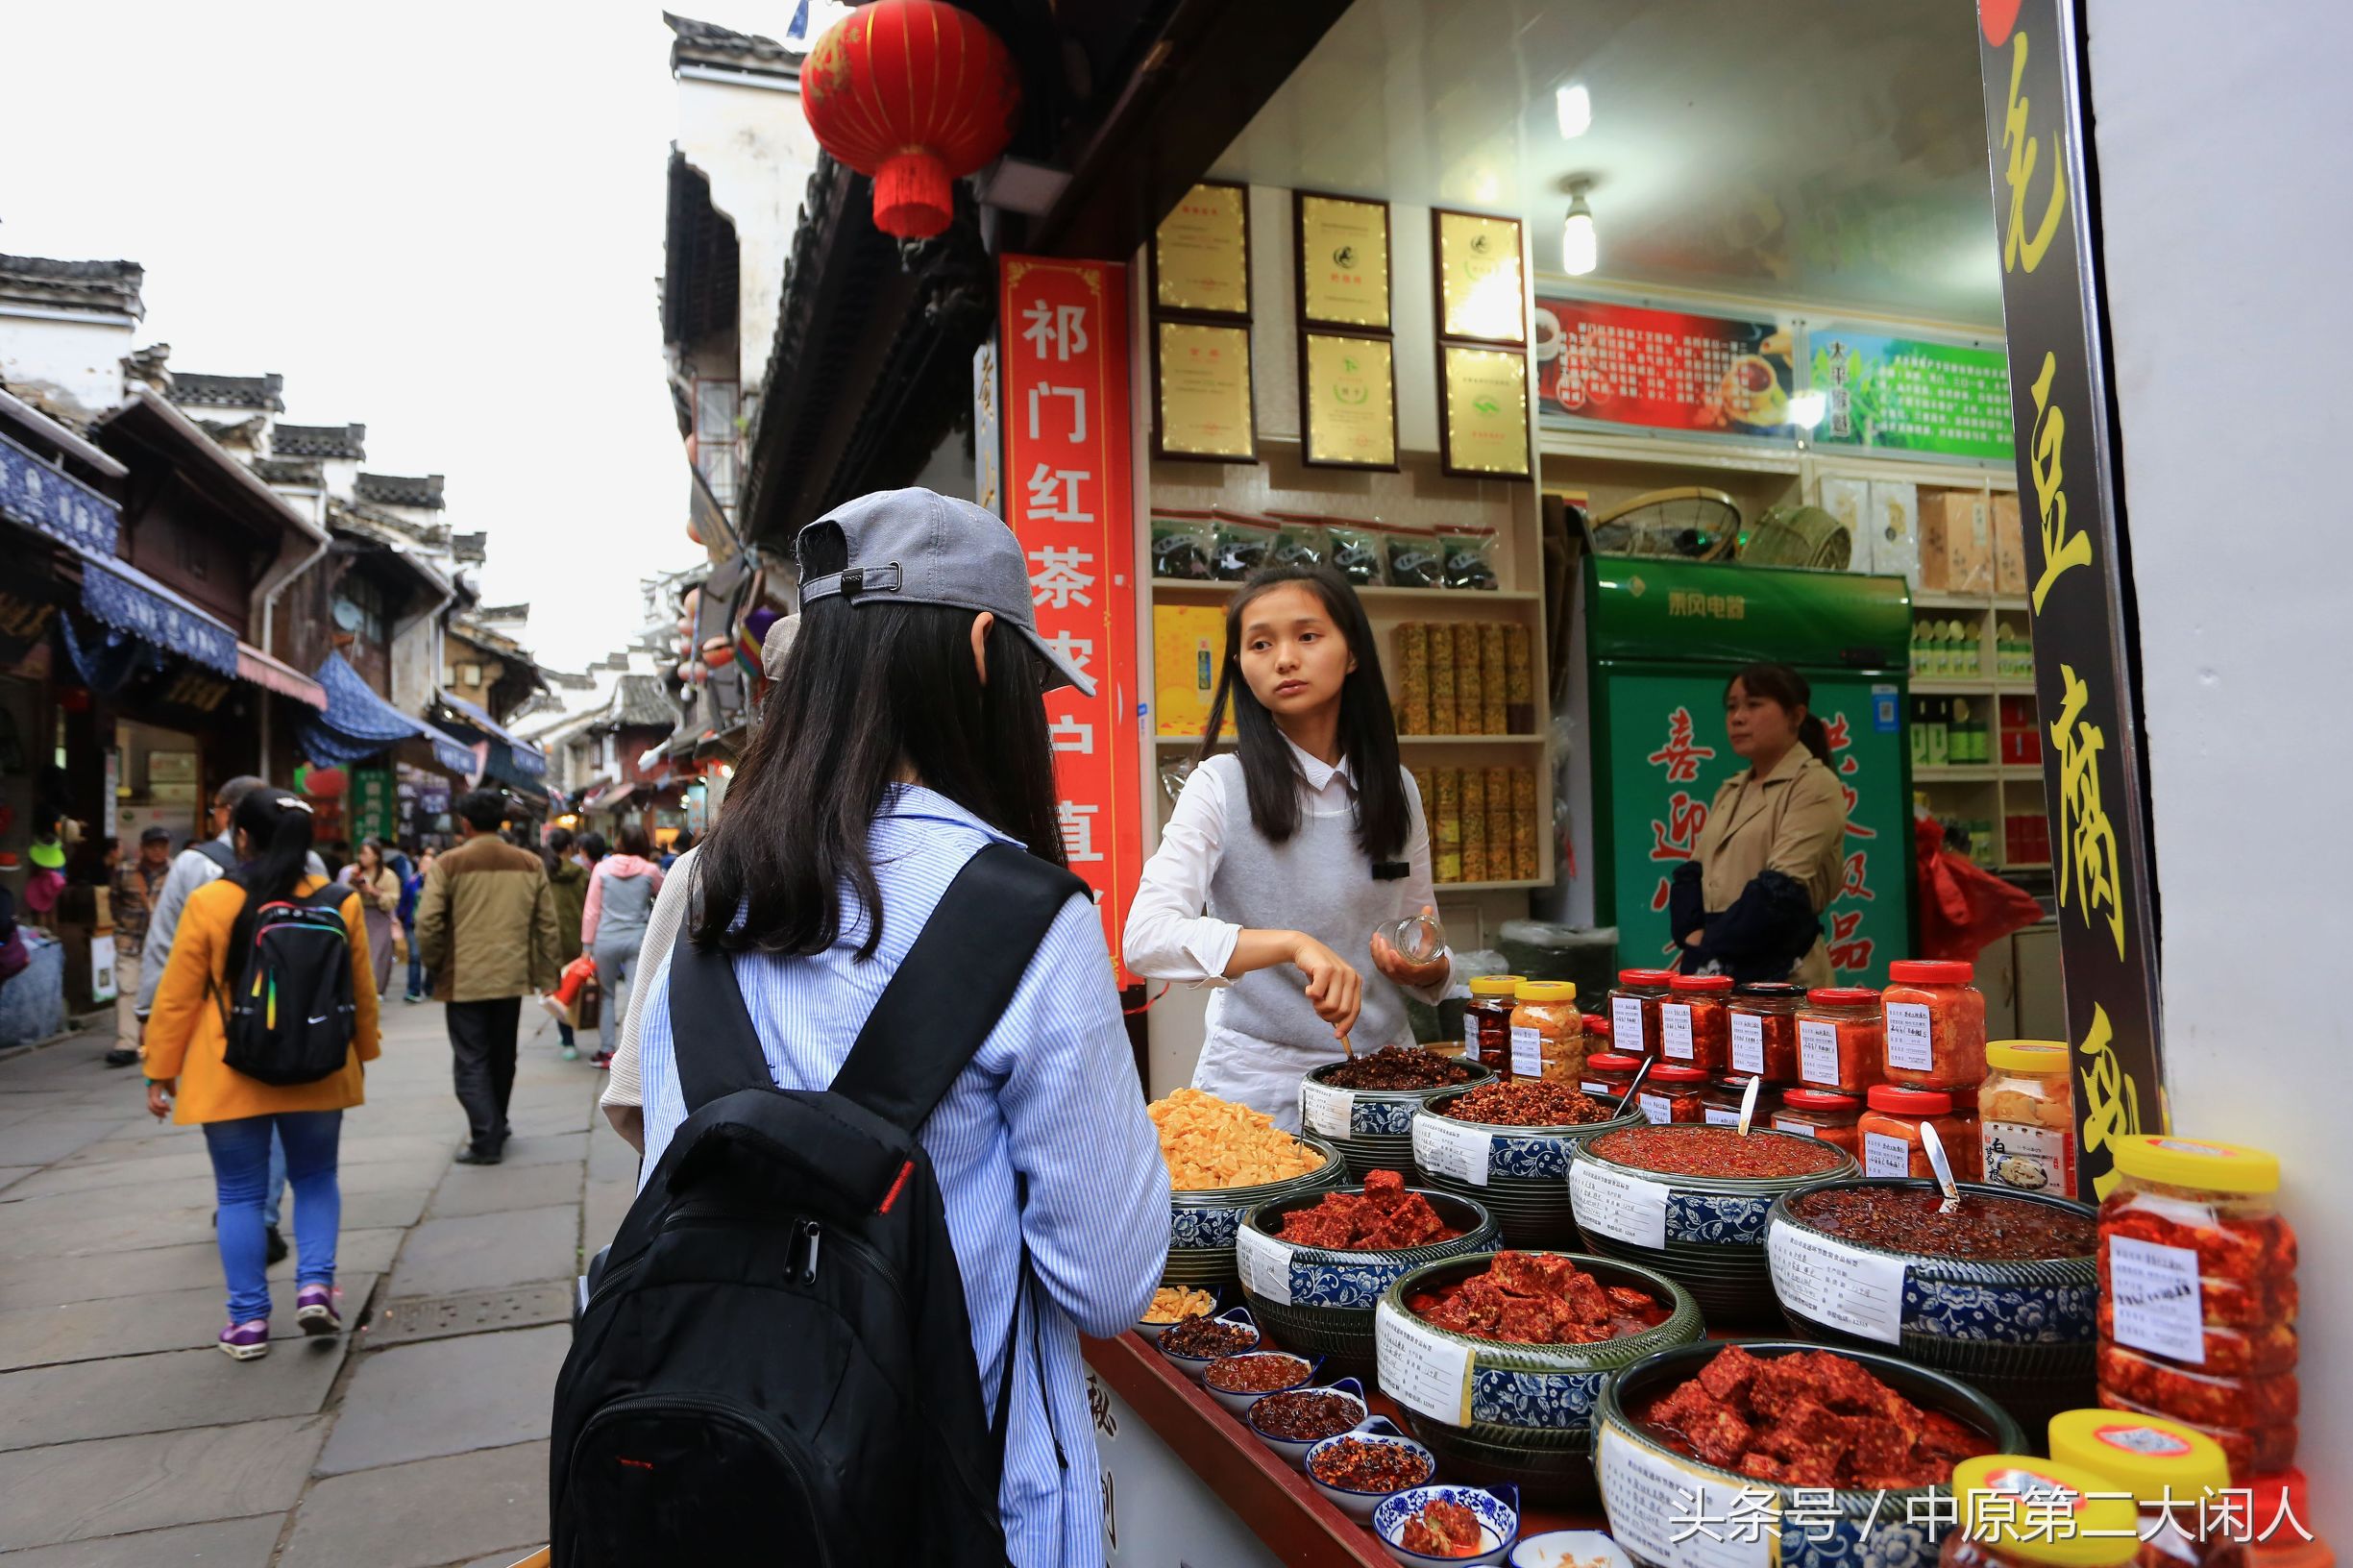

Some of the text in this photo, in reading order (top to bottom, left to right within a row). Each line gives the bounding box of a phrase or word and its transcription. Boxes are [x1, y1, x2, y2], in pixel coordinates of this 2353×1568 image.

[1021, 298, 1104, 937] 祁门红茶农户直
